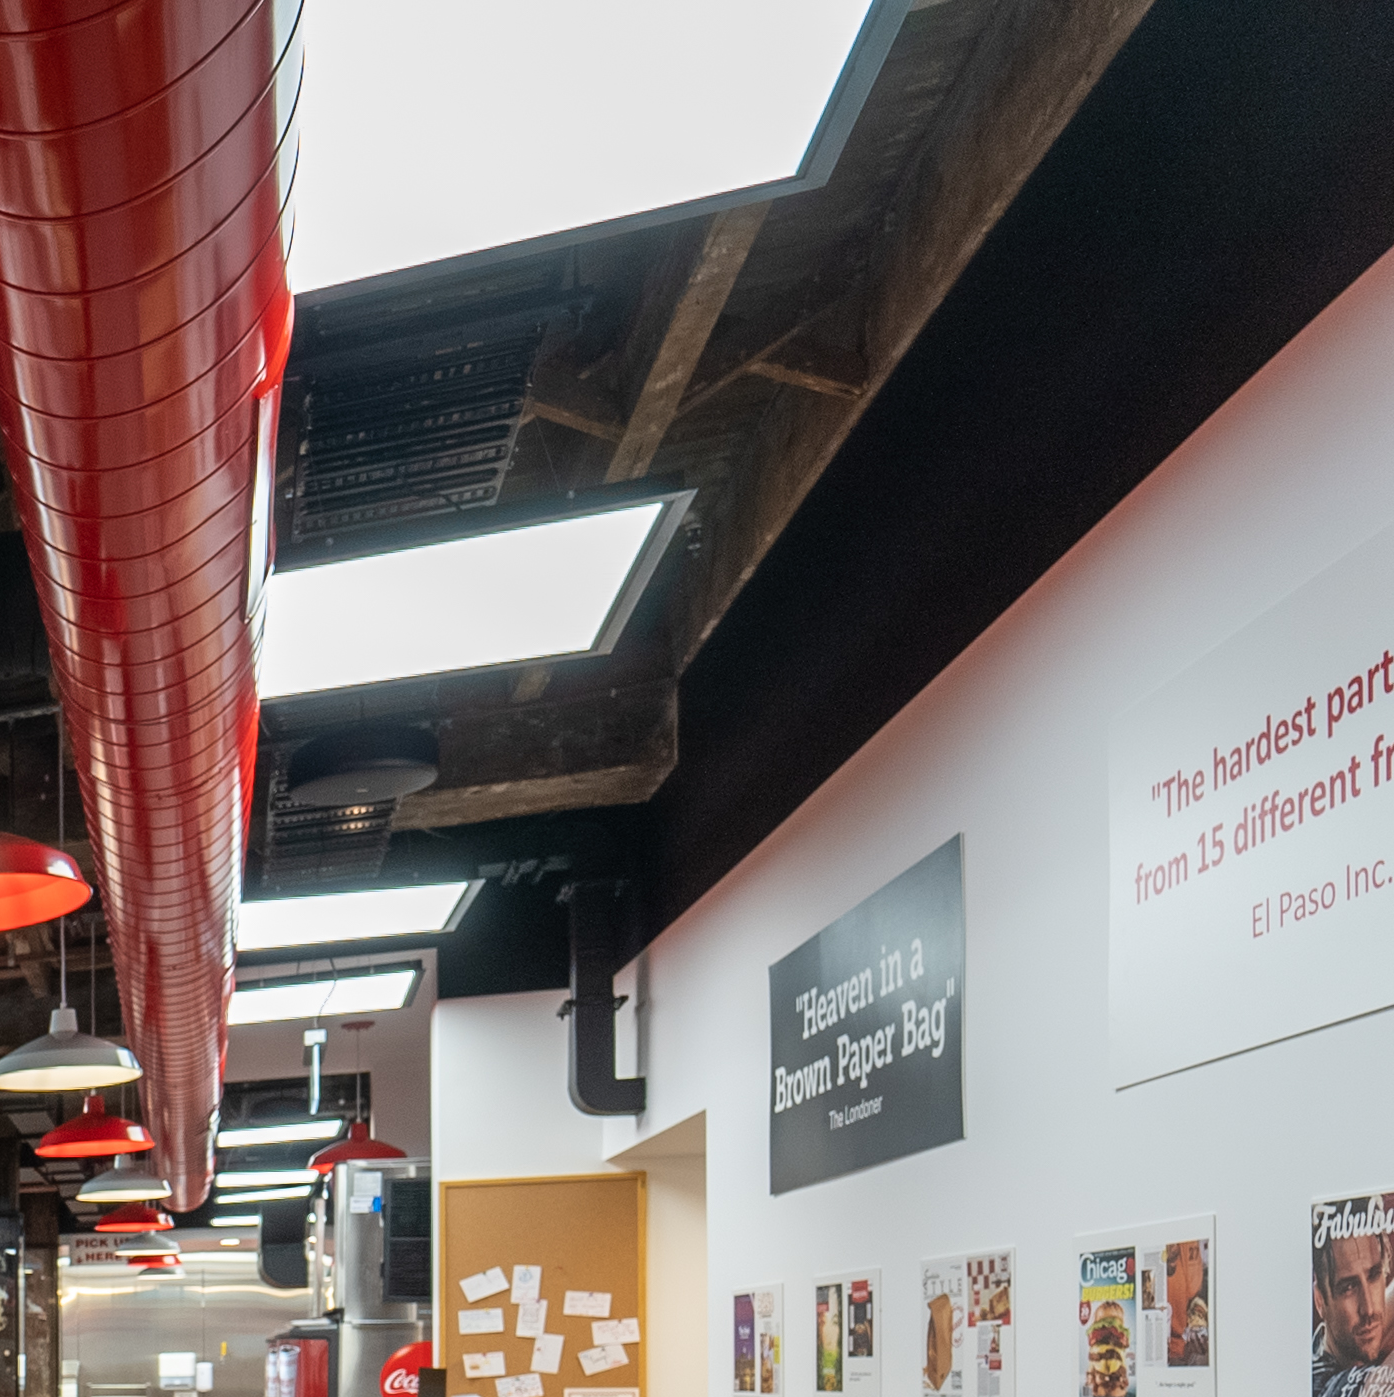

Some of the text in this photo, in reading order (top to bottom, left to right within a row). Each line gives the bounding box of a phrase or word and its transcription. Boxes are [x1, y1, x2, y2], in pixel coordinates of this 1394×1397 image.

[1151, 768, 1205, 818] "The
[1212, 696, 1317, 792] hardest
[1134, 852, 1188, 905] from
[1197, 823, 1225, 875] 15
[1233, 755, 1361, 856] different
[1252, 859, 1393, 938] El Paso Inc.
[796, 937, 924, 1040] "Heaven in a
[774, 977, 955, 1114] Brown Paper Bag"
[828, 1095, 883, 1131] The Londoner
[75, 1238, 109, 1248] PICK
